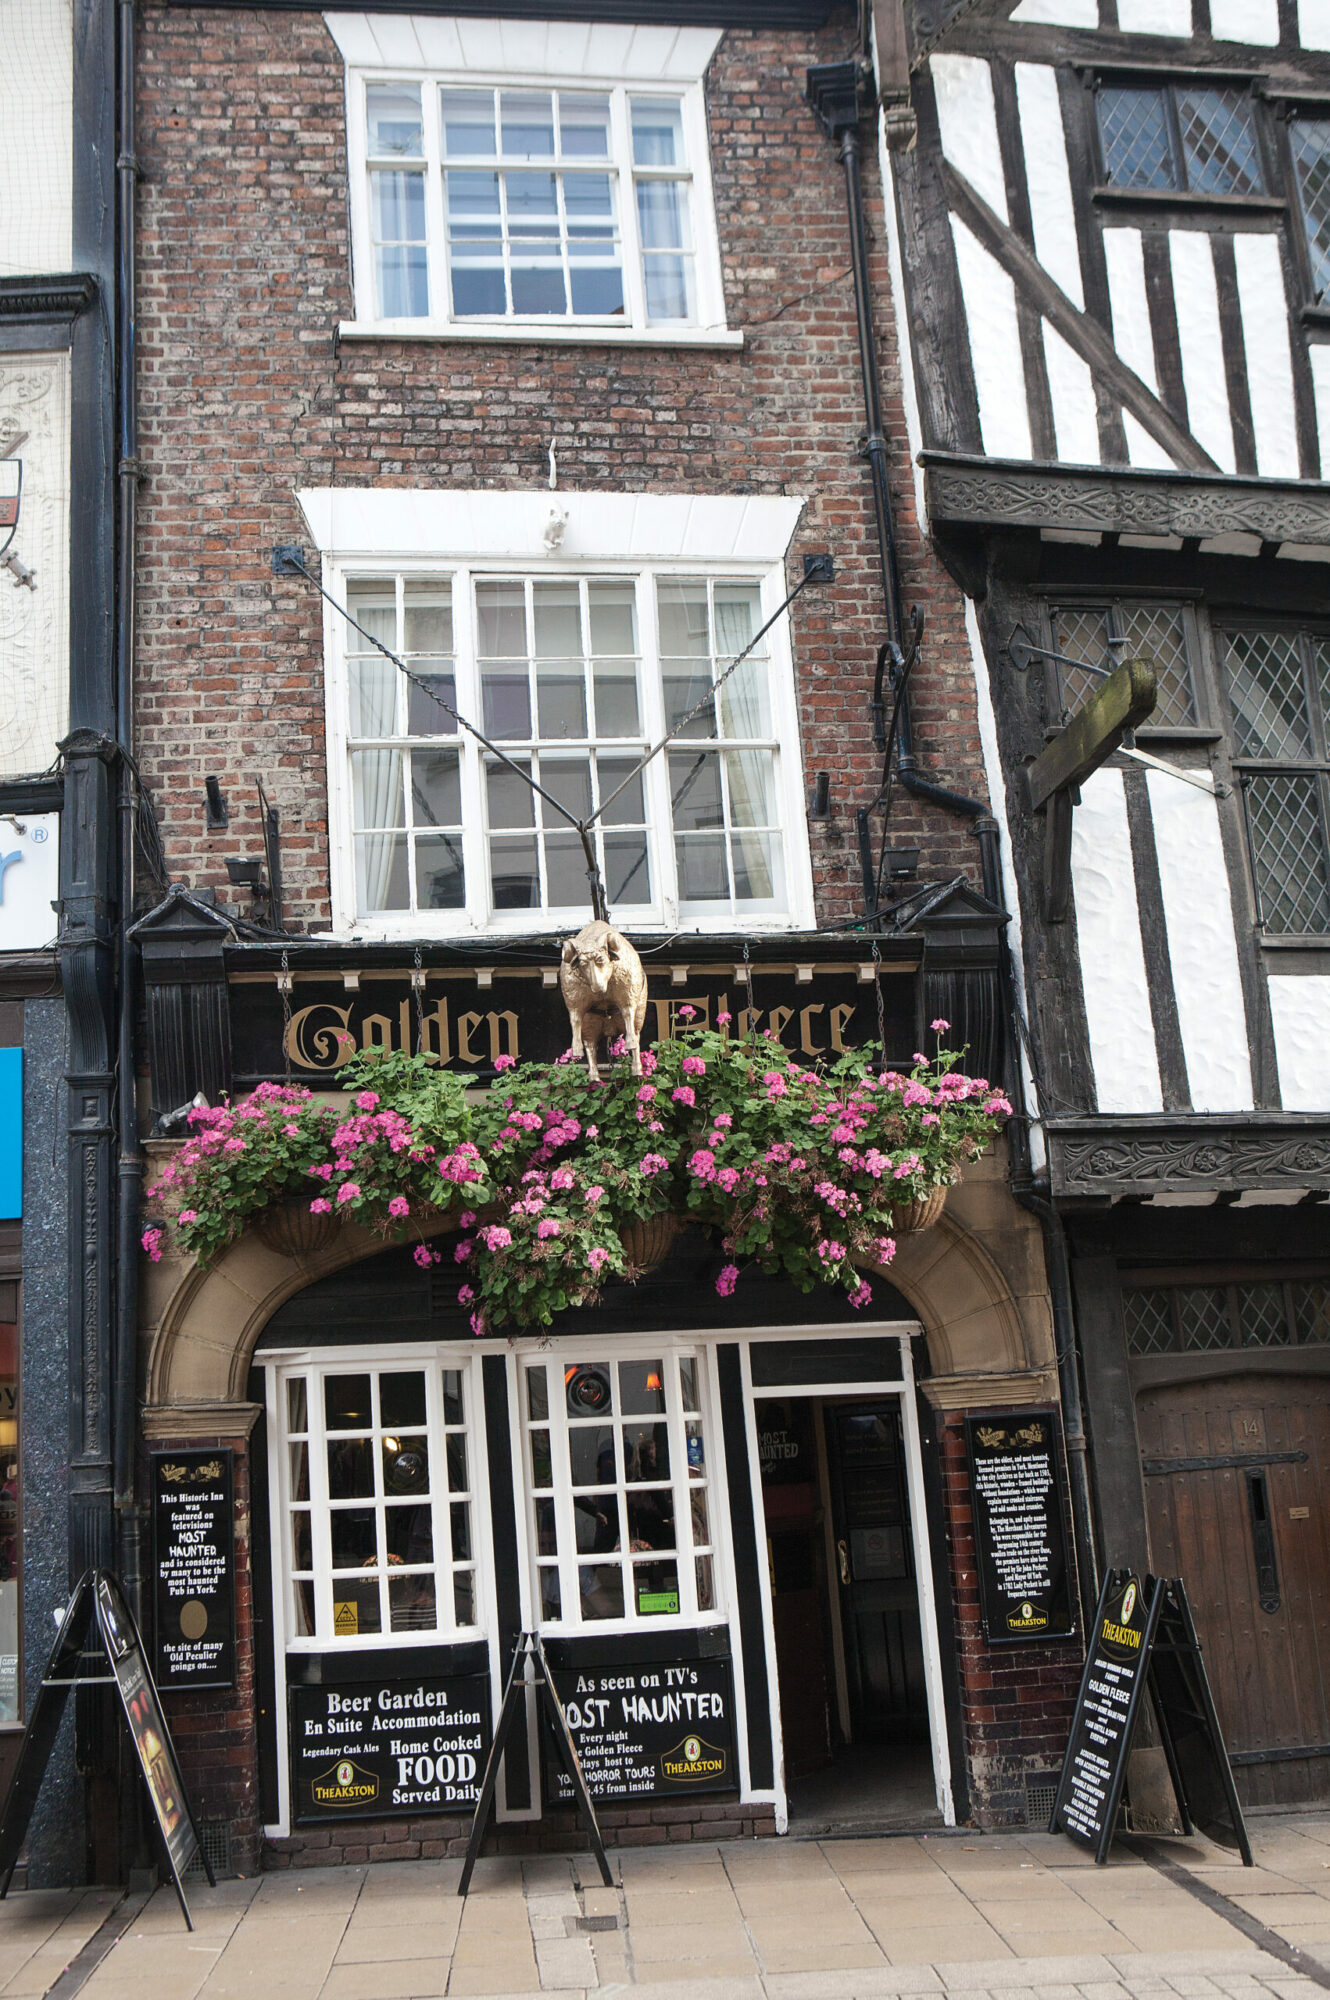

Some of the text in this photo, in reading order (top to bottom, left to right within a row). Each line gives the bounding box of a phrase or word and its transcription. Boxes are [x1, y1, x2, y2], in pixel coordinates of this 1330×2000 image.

[285, 992, 858, 1070] Golden Fleece
[1242, 1419, 1259, 1436] 14
[758, 1430, 788, 1446] MOST
[760, 1443, 799, 1460] AUNTED
[161, 1492, 223, 1503] This Historic Inn
[172, 1511, 202, 1521] featured
[173, 1520, 212, 1530] televisions
[179, 1530, 206, 1544] MOST
[169, 1544, 216, 1558] HAUNTED
[160, 1556, 225, 1568] and is considered
[160, 1569, 169, 1579] by
[171, 1570, 192, 1578] many
[203, 1566, 212, 1575] be
[214, 1566, 225, 1574] the
[187, 1575, 218, 1585] haunted
[170, 1584, 216, 1596] Pub in York.
[1009, 1618, 1046, 1627] THEAKSTON
[1102, 1619, 1141, 1649] THEAKSTON
[164, 1644, 176, 1652] the
[177, 1643, 192, 1651] site
[193, 1642, 202, 1650] of
[170, 1650, 217, 1661] Old Peculier
[171, 1662, 196, 1672] goings
[576, 1667, 698, 1693] As seen on TV's
[1088, 1679, 1130, 1704] GOLDEN FLEECE
[327, 1687, 448, 1714] Beer Garden
[621, 1692, 724, 1725] HAUNTED
[305, 1709, 481, 1735] En Suite Accommodation
[579, 1730, 628, 1744] Every night
[303, 1743, 379, 1758] Legendary Cask Ales
[390, 1734, 482, 1756] Home Cooked
[585, 1744, 614, 1756] Golden
[616, 1743, 643, 1754] Fleece
[604, 1756, 623, 1767] host
[625, 1756, 633, 1766] to
[664, 1759, 722, 1774] THEAKSTON
[397, 1753, 477, 1786] FOOD
[585, 1768, 621, 1783] HORROR
[625, 1765, 655, 1779] TOURS
[315, 1784, 375, 1799] THEAKSTON
[392, 1784, 483, 1804] Served Daily
[606, 1783, 627, 1794] from
[629, 1781, 655, 1792] inside
